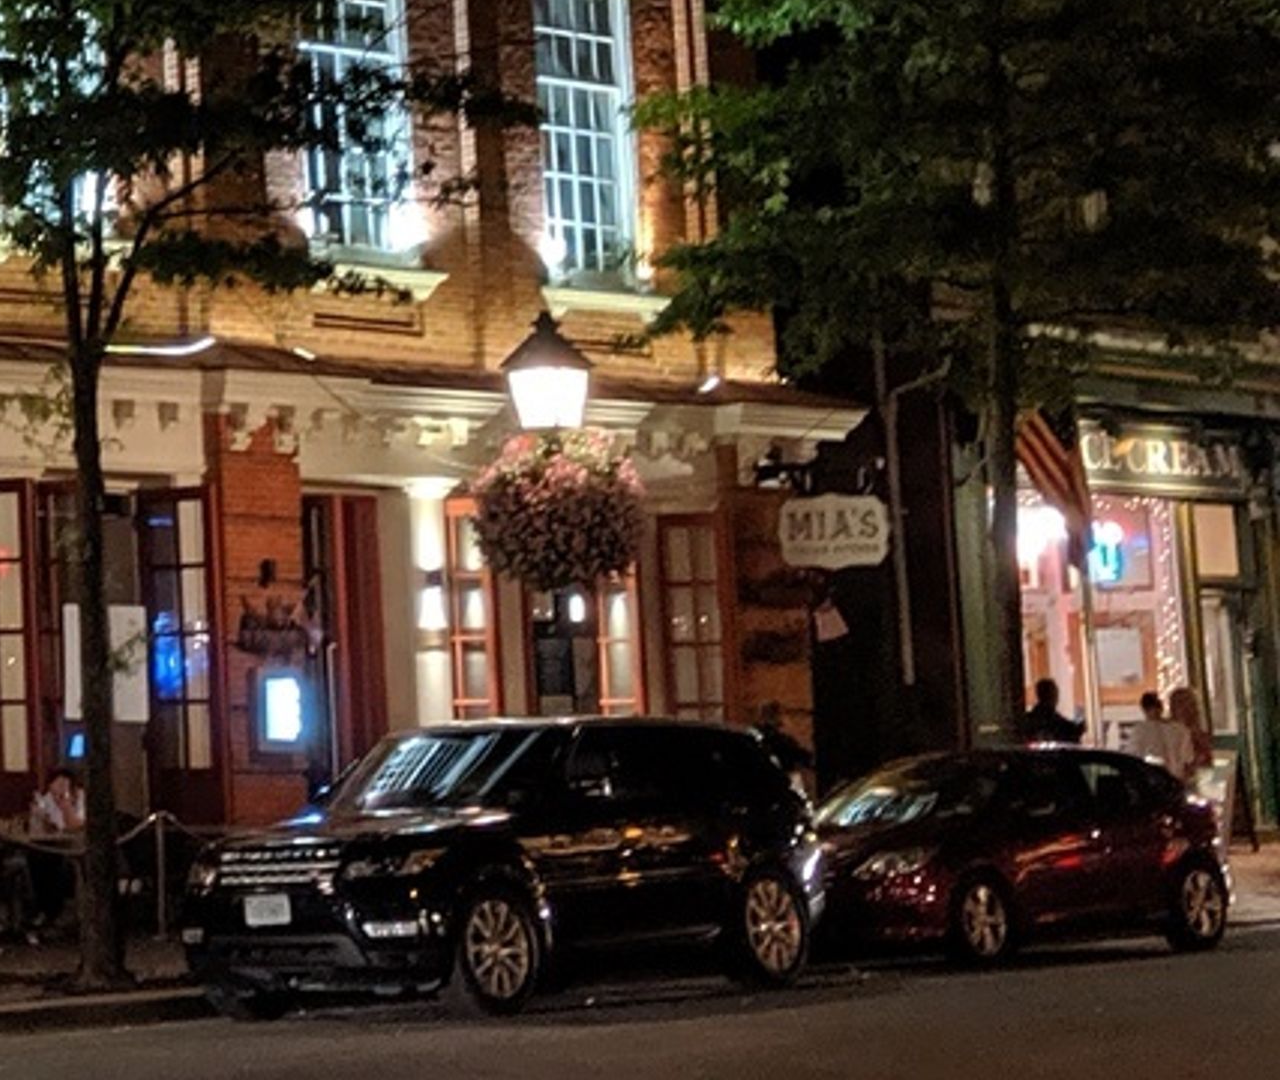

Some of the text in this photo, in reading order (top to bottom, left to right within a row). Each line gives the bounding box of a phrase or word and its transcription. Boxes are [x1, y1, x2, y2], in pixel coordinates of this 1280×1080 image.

[1079, 430, 1241, 479] CE CREAM
[787, 508, 880, 541] MIA'S
